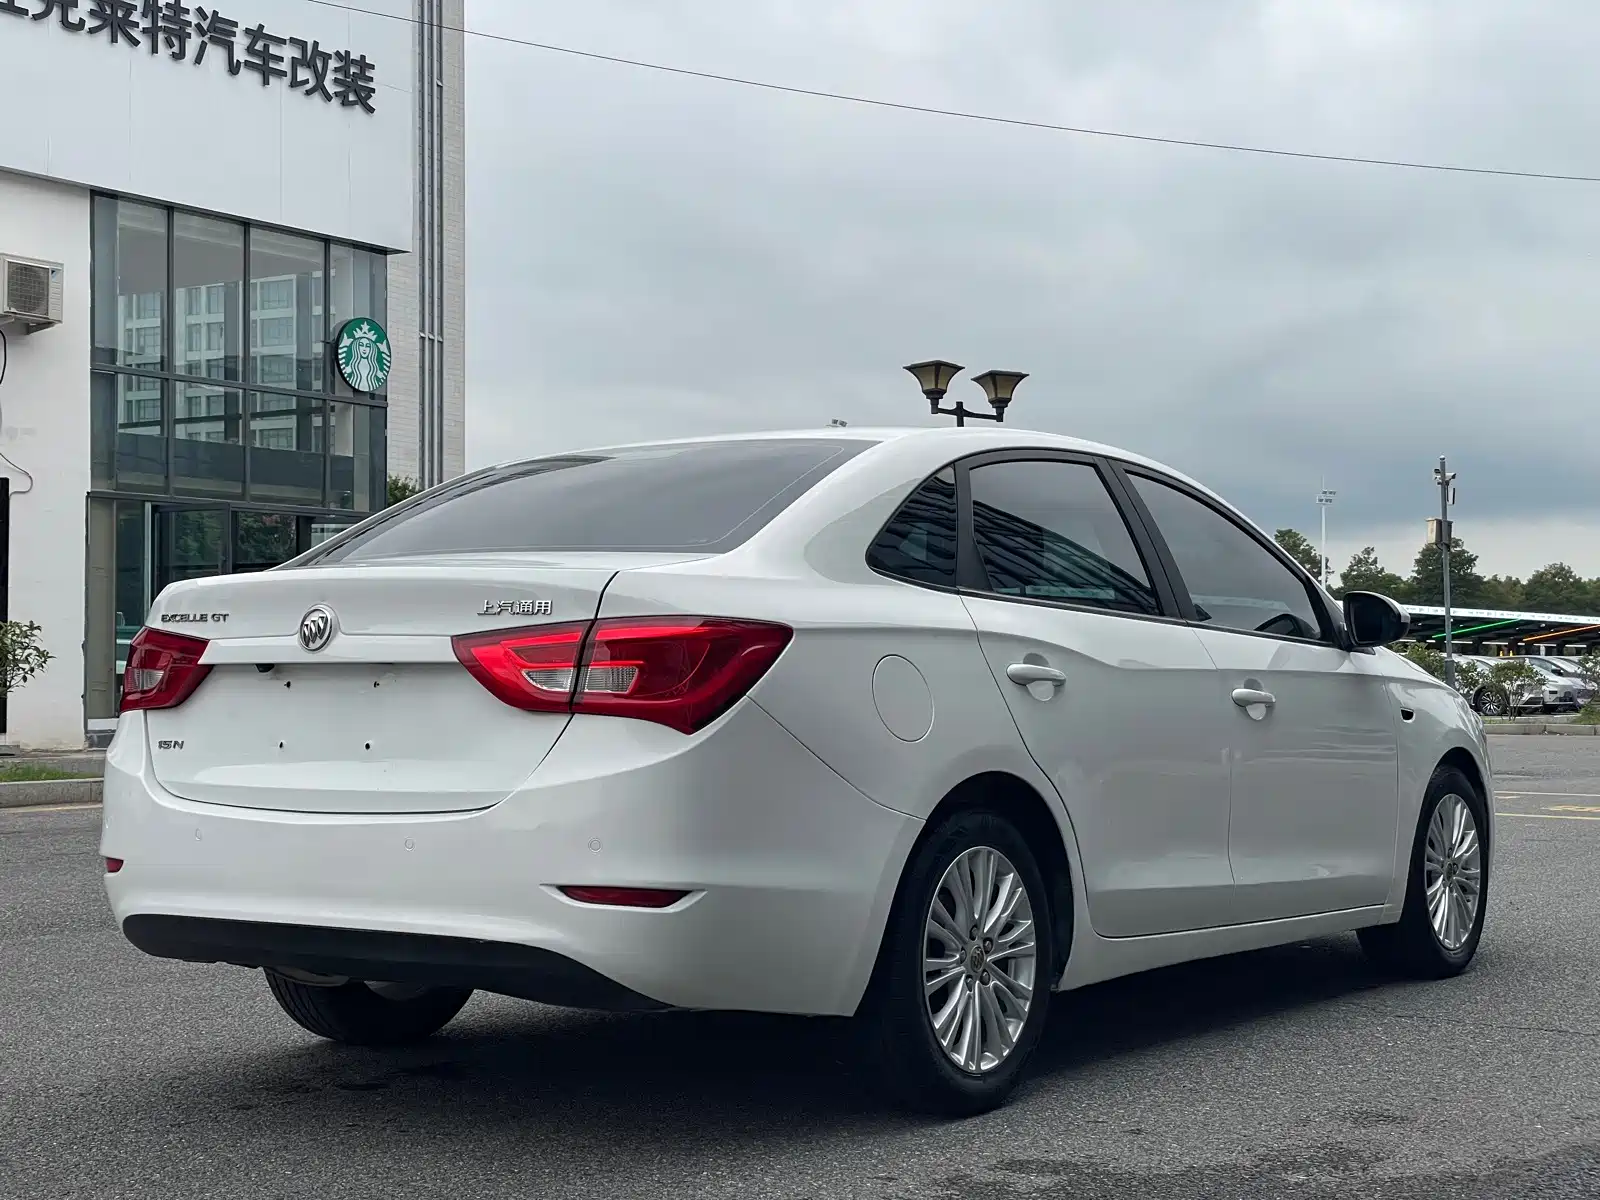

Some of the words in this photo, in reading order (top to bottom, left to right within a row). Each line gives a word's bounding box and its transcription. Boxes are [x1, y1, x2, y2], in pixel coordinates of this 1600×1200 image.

[0, 0, 376, 114] 莱特汽车改装
[477, 599, 553, 616] 上汽通用
[161, 613, 208, 623] EXCELLE
[211, 613, 230, 623] GT
